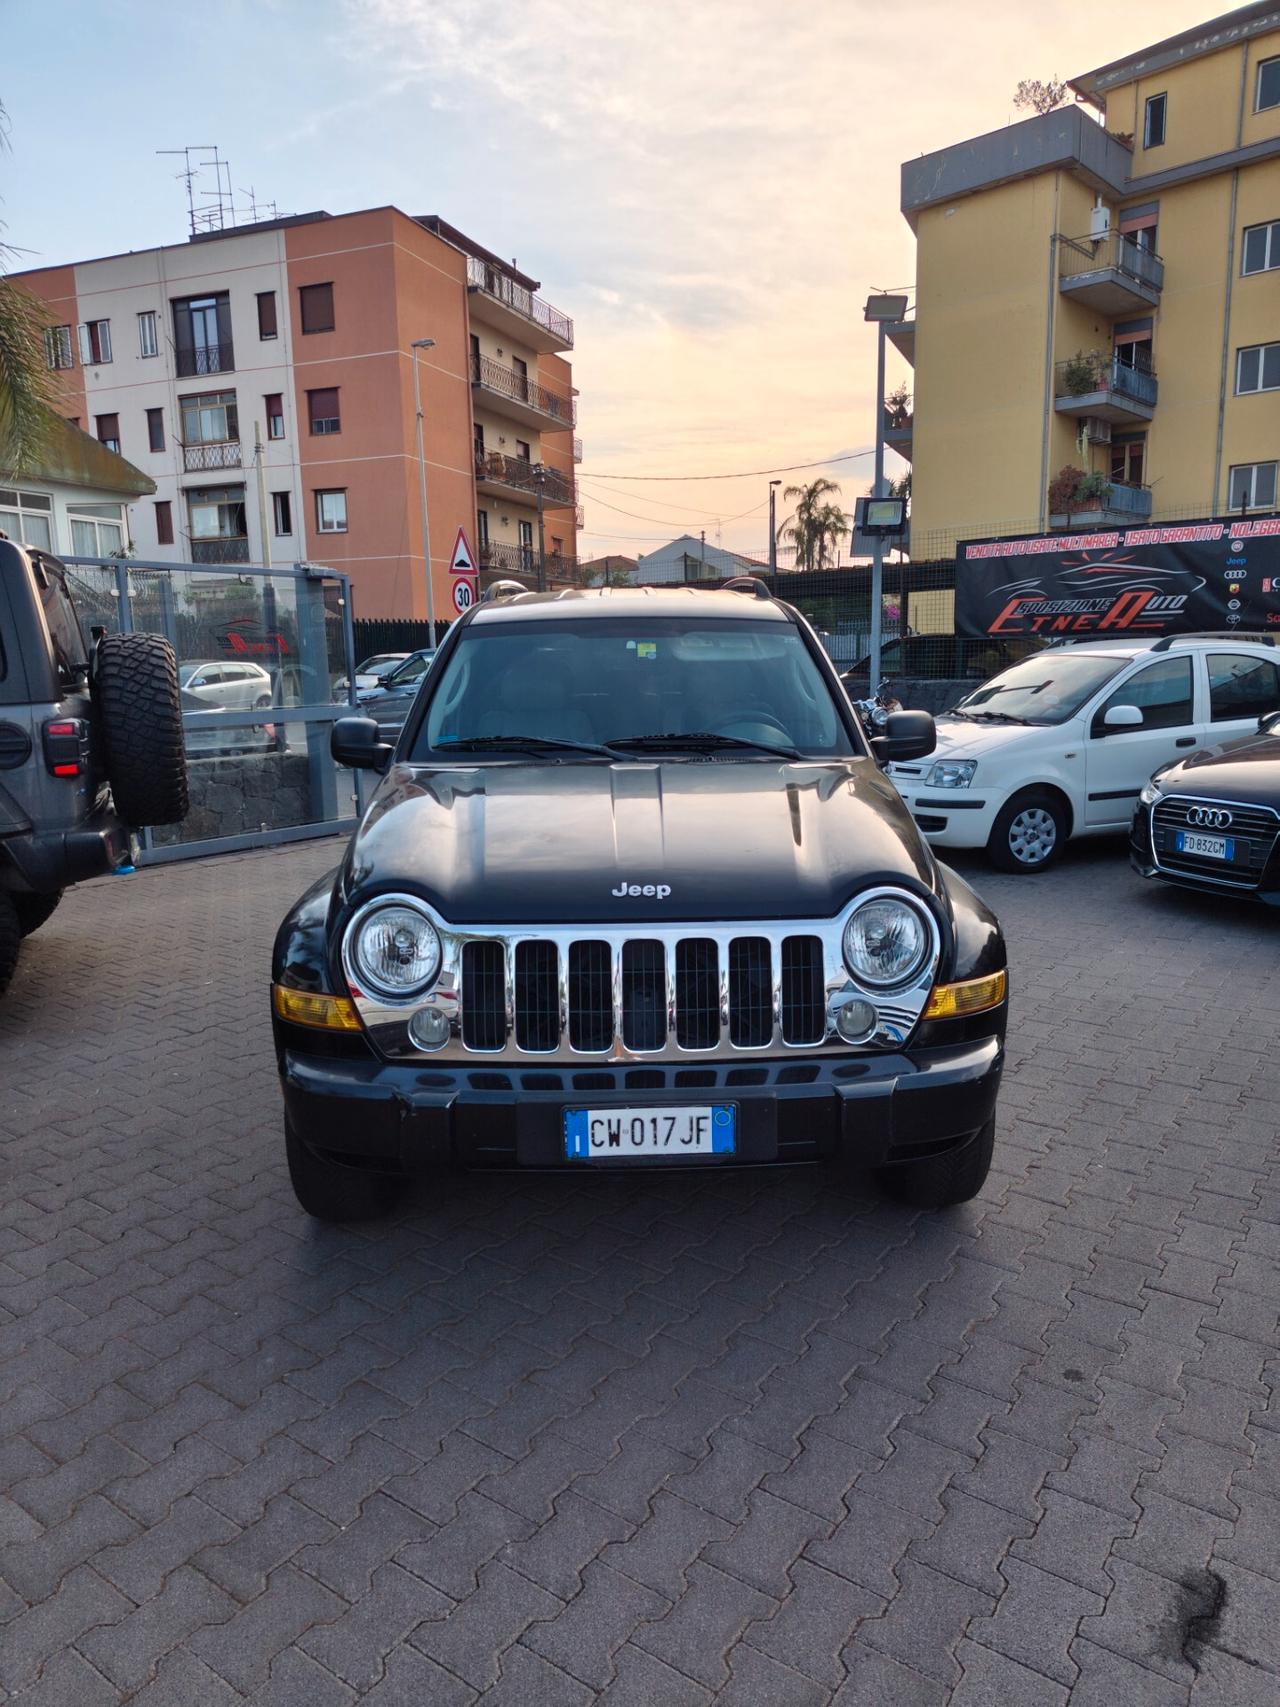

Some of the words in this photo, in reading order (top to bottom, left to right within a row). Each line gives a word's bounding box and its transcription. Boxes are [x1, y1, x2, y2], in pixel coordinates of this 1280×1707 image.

[966, 543, 1002, 559] VENDITA
[1003, 540, 1028, 557] AUTO
[1027, 538, 1058, 555] USATE
[1058, 532, 1119, 551] MULTIMARCA
[1124, 529, 1160, 546] USATO
[1160, 524, 1224, 543] GARANTITO
[1226, 558, 1247, 566] Jeep
[457, 587, 470, 607] 30
[612, 882, 671, 899] Jeep
